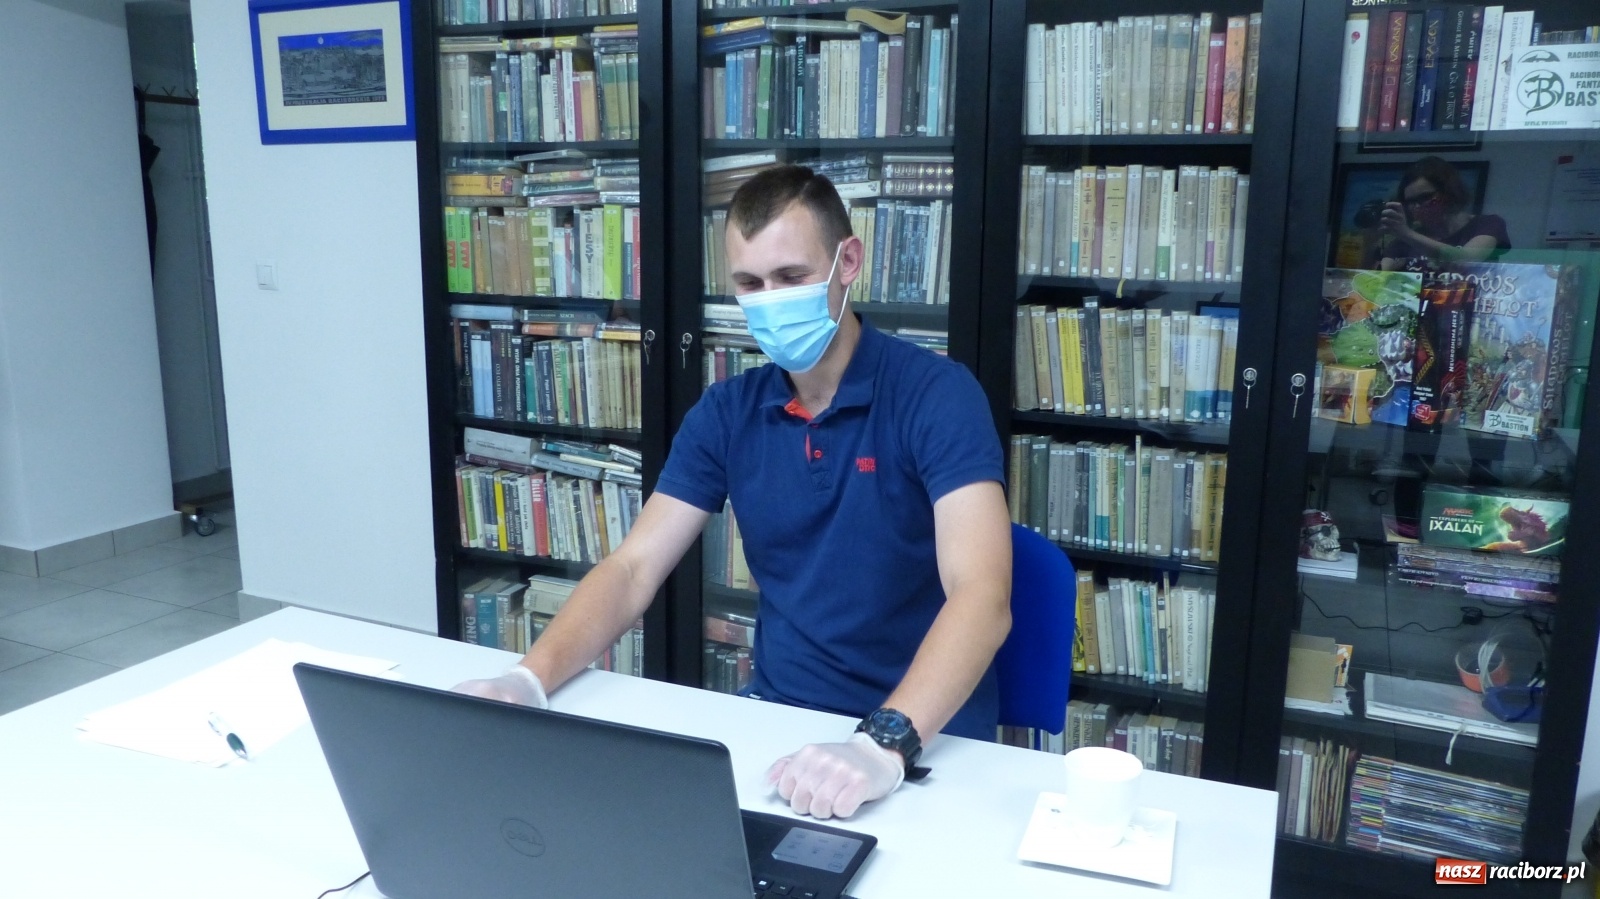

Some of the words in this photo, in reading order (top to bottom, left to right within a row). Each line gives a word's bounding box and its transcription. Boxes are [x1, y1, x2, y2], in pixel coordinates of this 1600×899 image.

[1455, 11, 1464, 32] GEORGE
[1424, 19, 1439, 68] ERAGON
[1467, 30, 1477, 60] ĆWIEK
[1452, 45, 1461, 69] MARTIN
[1448, 72, 1459, 90] GRA
[1448, 329, 1456, 372] NEUROSHIMA
[1543, 328, 1562, 410] SHADOWS
[1501, 421, 1529, 431] BASTION
[1429, 520, 1485, 536] IXALAN
[507, 830, 542, 846] DELL
